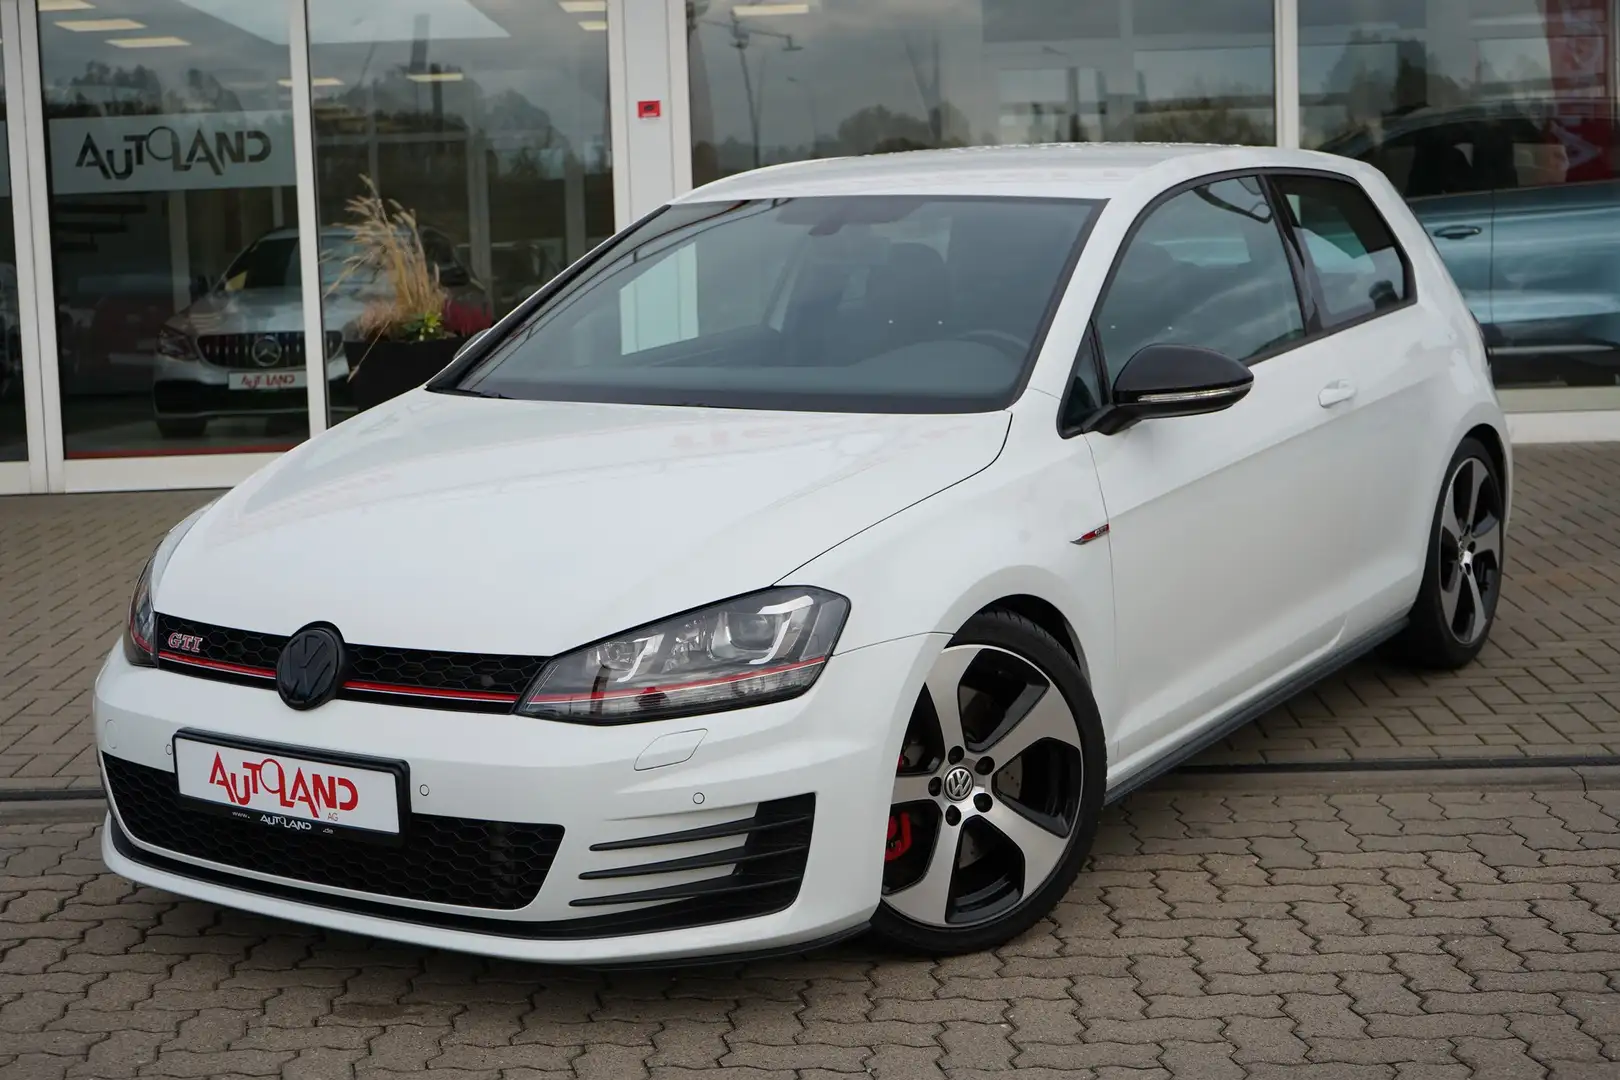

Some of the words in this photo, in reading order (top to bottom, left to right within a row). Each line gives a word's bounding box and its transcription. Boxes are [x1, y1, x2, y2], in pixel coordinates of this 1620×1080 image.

[75, 126, 272, 180] AUTOLAND
[241, 374, 296, 389] AUTLAND
[168, 632, 203, 653] GTI
[209, 751, 359, 818] AUTOLAND
[232, 811, 250, 819] www.
[260, 814, 312, 830] AUTOLAND
[327, 812, 339, 821] AG
